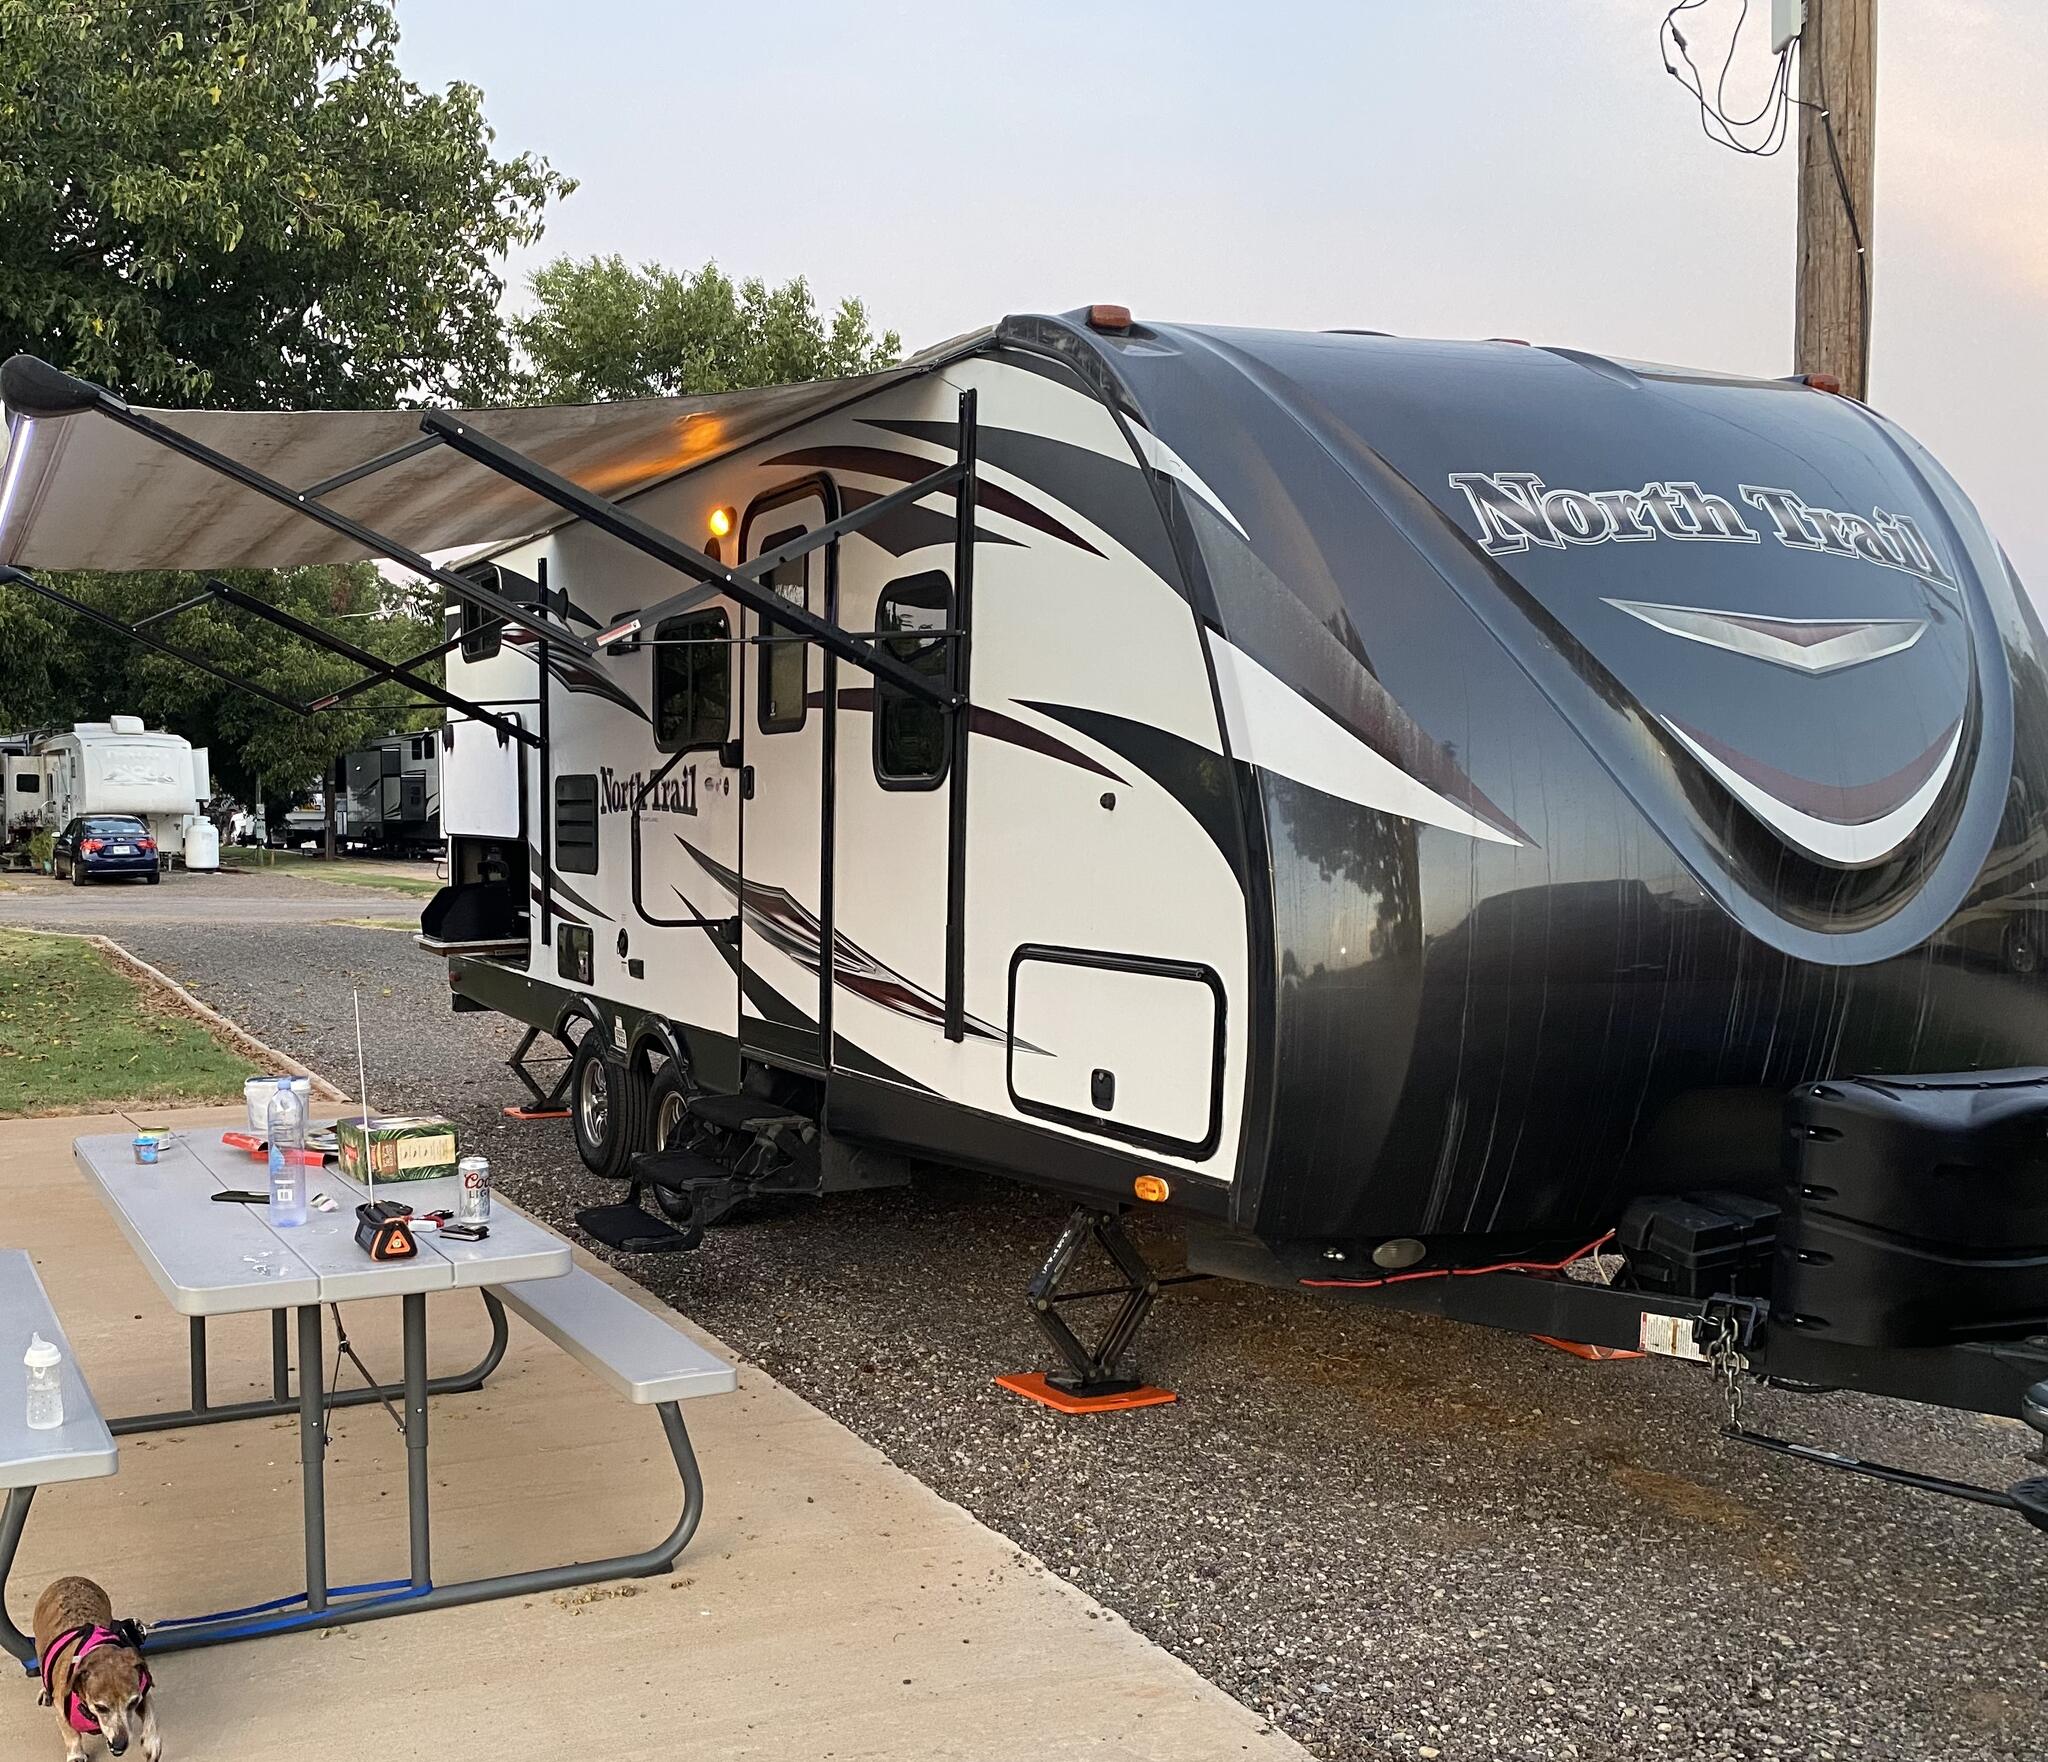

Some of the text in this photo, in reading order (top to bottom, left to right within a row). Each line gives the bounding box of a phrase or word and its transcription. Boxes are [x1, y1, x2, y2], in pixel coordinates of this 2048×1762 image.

[1450, 473, 1957, 591] North Trail
[600, 764, 697, 816] North Trail
[469, 1189, 489, 1199] LIG
